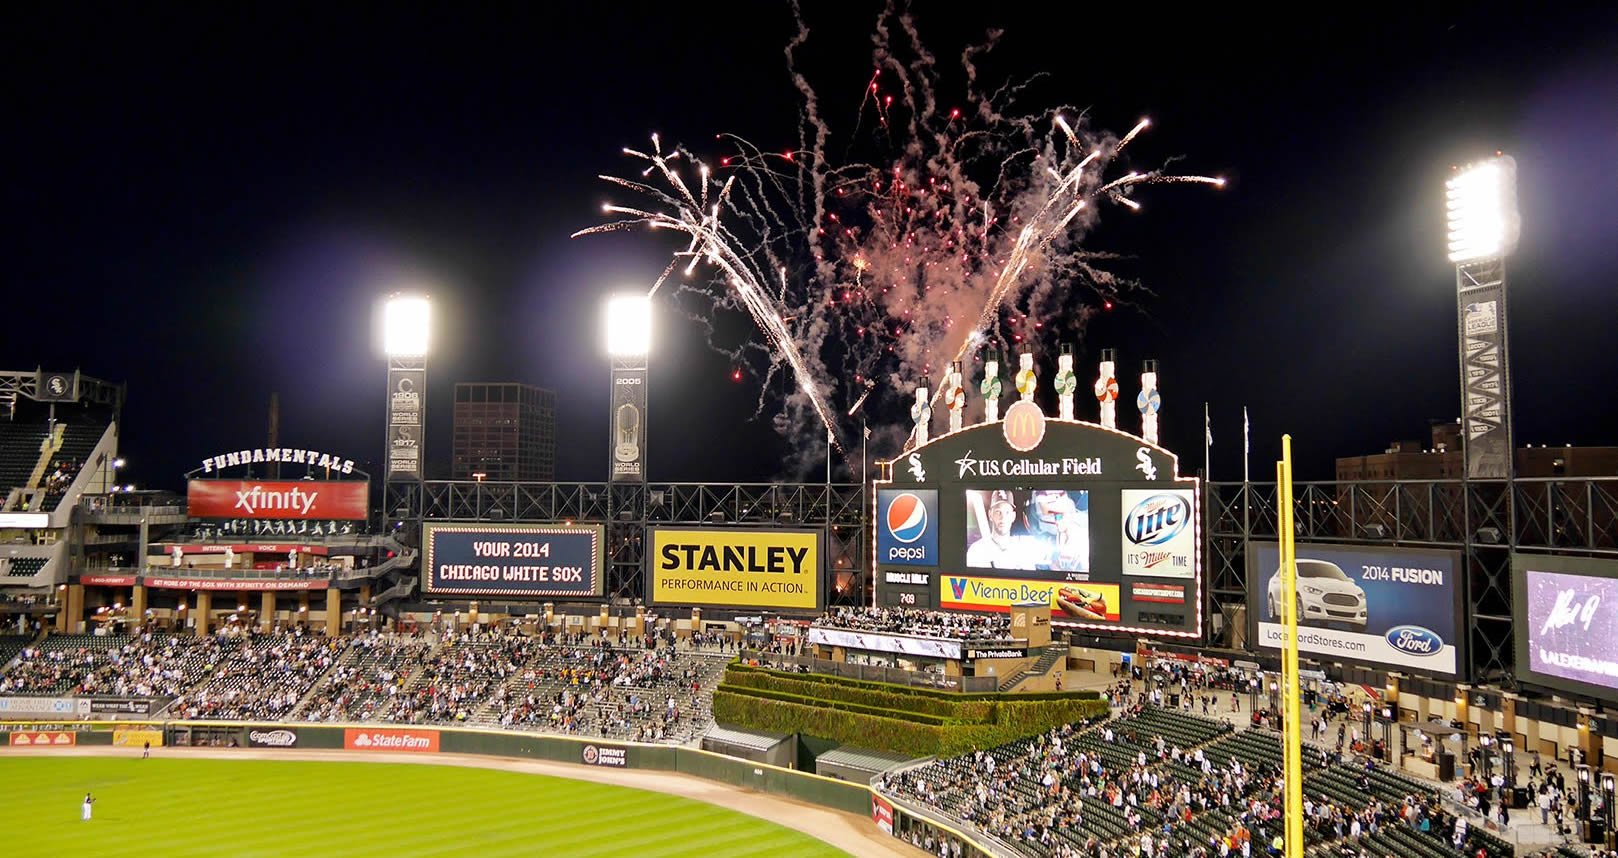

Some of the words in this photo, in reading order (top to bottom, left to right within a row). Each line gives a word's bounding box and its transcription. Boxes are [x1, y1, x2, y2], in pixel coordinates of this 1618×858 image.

[202, 448, 354, 474] FUNDAMENTALS
[979, 459, 1000, 476] U.S.
[1002, 458, 1060, 476] Cellular
[1062, 457, 1102, 475] Field
[235, 485, 318, 515] xfinity
[473, 541, 510, 557] YOUR
[513, 542, 550, 558] 2014
[661, 543, 809, 574] STANLEY
[889, 545, 925, 560] pepsi
[1128, 553, 1139, 564] IT'S
[1140, 551, 1172, 568] Miller
[1172, 555, 1187, 567] TIME
[440, 565, 500, 580] CHICAGO
[503, 566, 549, 582] WHITE
[552, 567, 582, 582] SOX
[1362, 565, 1390, 581] 2014
[1391, 567, 1443, 585] FUSION
[661, 578, 743, 592] PERFORMANCE
[746, 581, 758, 592] IN
[761, 582, 803, 593] ACTION
[970, 580, 1018, 600] Vienna
[1020, 584, 1053, 604] Beef
[1267, 629, 1366, 651] LocaordStores.com
[1396, 630, 1432, 653] Ford
[988, 650, 1022, 658] PrivateBank
[599, 747, 626, 757] JIMMY
[599, 756, 626, 765] JOHN'S
